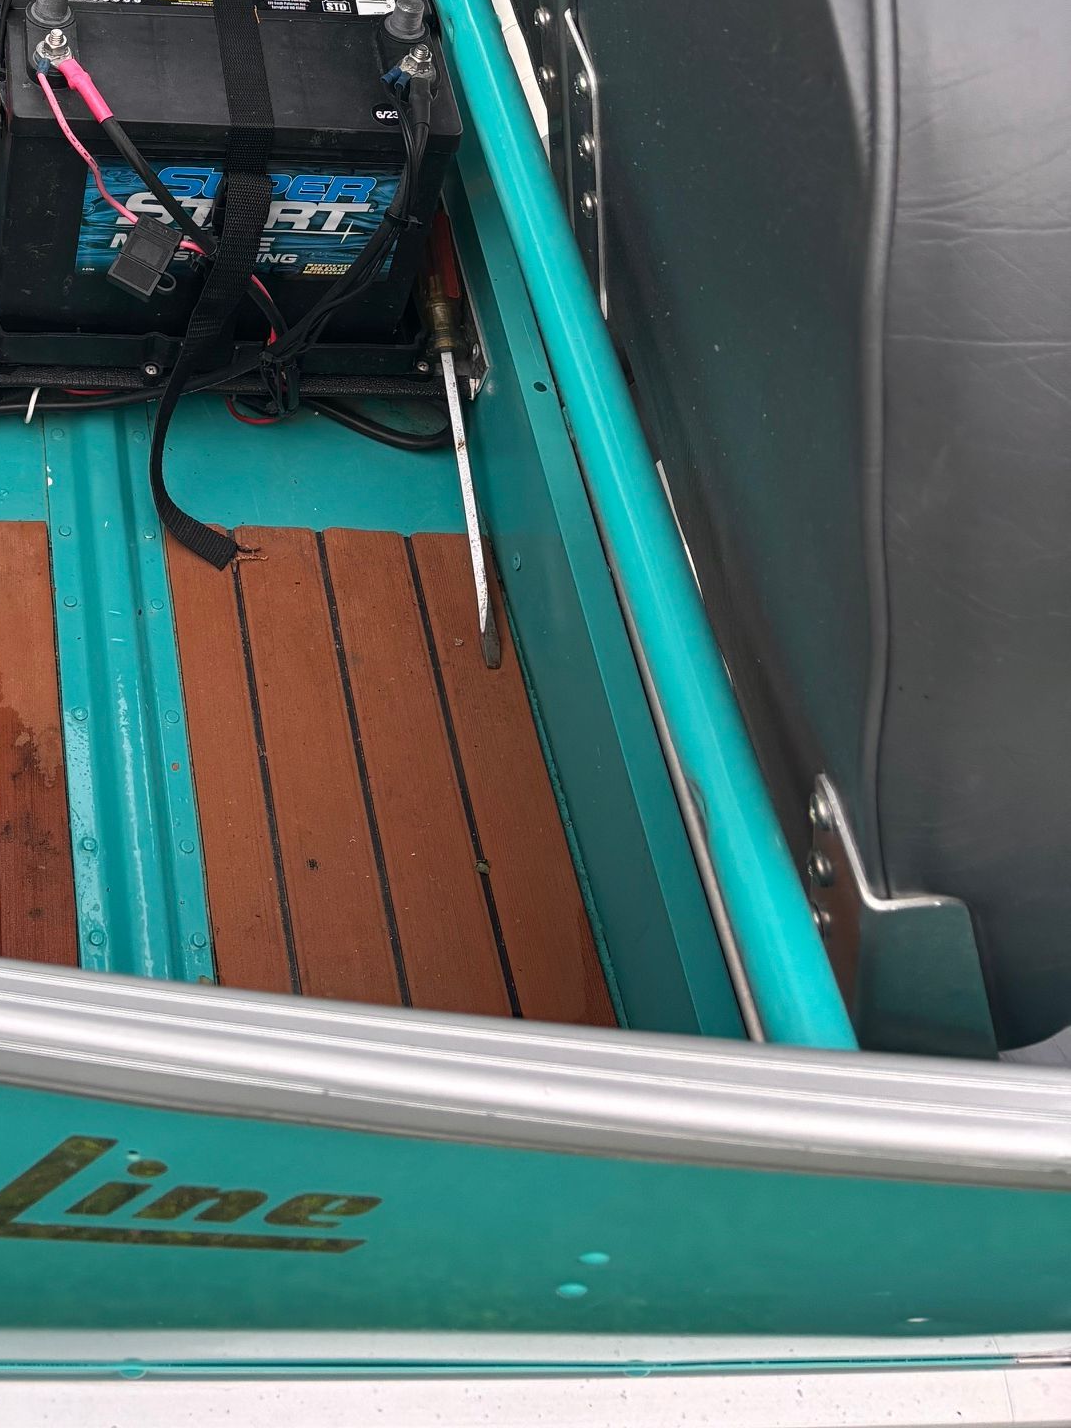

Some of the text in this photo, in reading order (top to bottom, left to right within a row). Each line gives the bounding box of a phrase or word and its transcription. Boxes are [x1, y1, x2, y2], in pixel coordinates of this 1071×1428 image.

[326, 2, 347, 10] STD
[376, 110, 398, 119] 6/23
[115, 192, 371, 231] STRT
